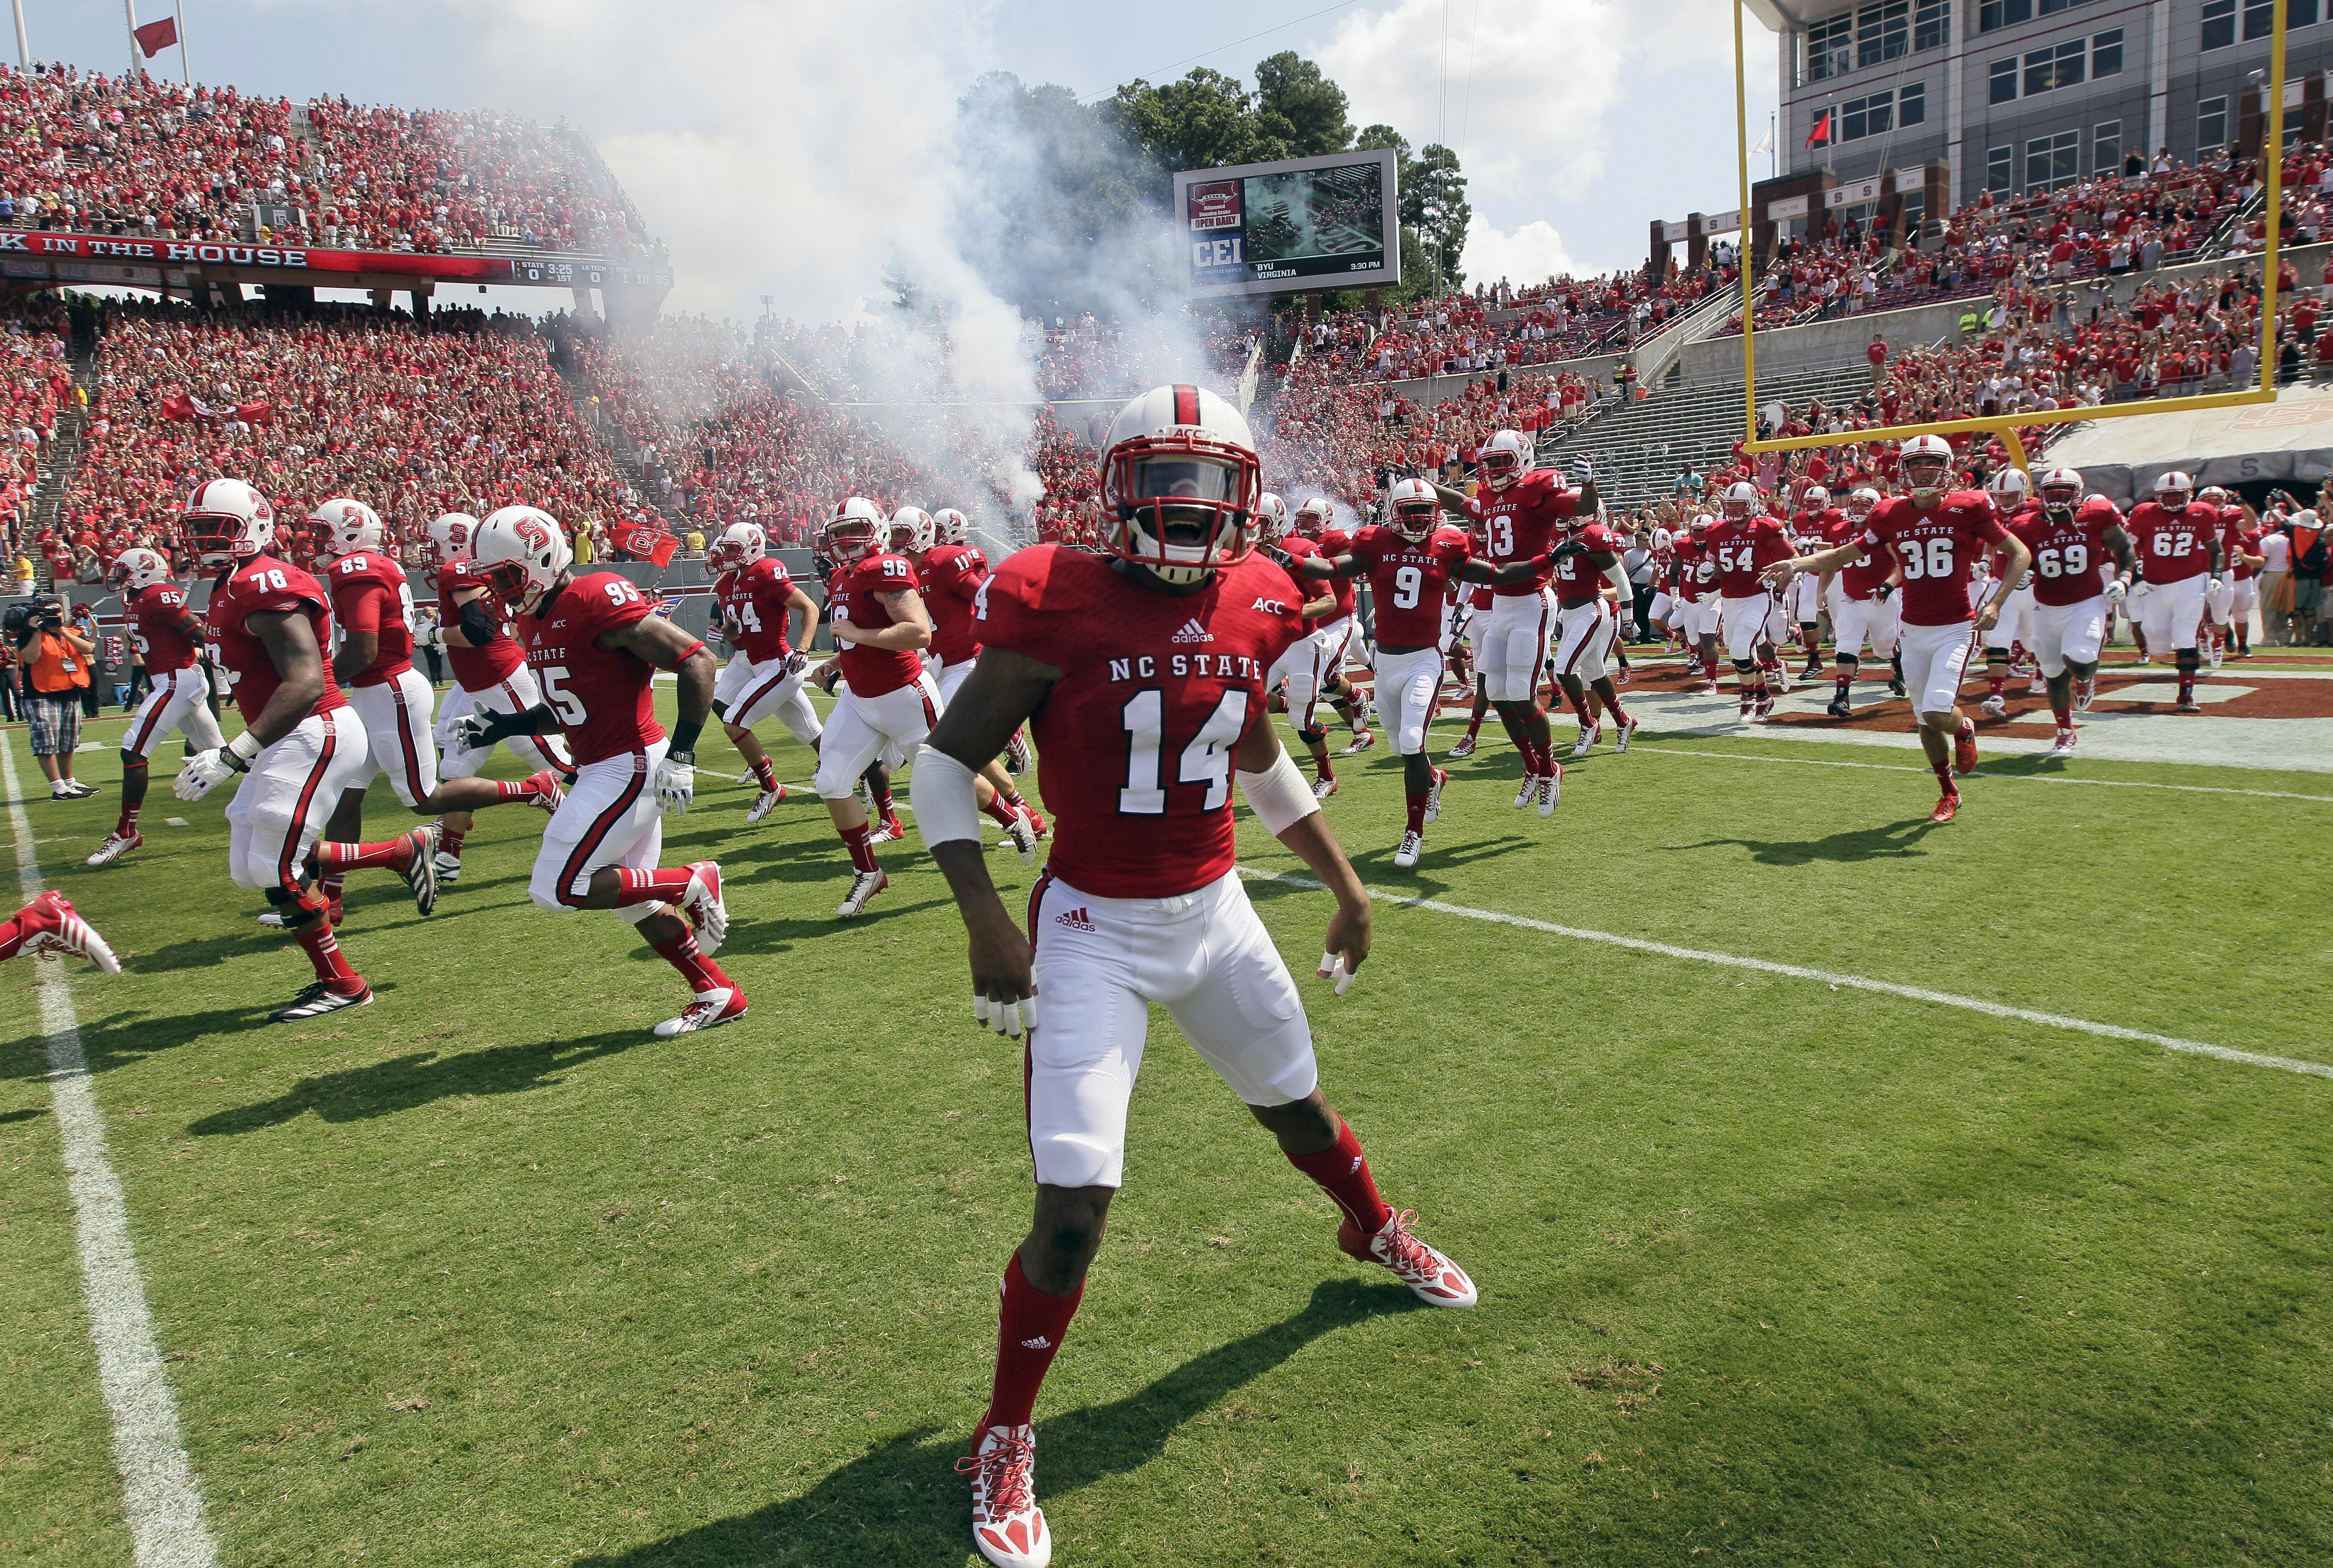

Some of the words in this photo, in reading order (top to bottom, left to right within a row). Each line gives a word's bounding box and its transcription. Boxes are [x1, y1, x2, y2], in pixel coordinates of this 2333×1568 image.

[1195, 217, 1214, 228] OPEN
[1216, 215, 1236, 226] DAILY
[42, 238, 78, 252] IN
[88, 241, 155, 257] THE
[166, 243, 307, 267] HOUSE
[1193, 238, 1242, 267] CEI
[529, 269, 539, 280] 0
[548, 264, 573, 275] 3:25
[1257, 263, 1273, 271] BYU
[1257, 269, 1297, 279] VIRGINIA
[591, 272, 600, 283] 0
[1174, 429, 1204, 438] ACC
[1552, 474, 1567, 490] 13
[1492, 503, 1517, 513] STATE
[1485, 515, 1514, 558] 13
[1897, 530, 1909, 539] NC
[1915, 527, 1954, 536] STATE
[2037, 540, 2049, 549] NC
[2054, 535, 2087, 544] STATE
[2153, 532, 2194, 557] 62
[340, 555, 368, 575] 89
[954, 554, 970, 571] 11
[1402, 555, 1438, 566] STATE
[1719, 547, 1754, 572] 54
[1898, 538, 1953, 580] 36
[2038, 544, 2087, 578] 69
[773, 566, 789, 580] 84
[882, 559, 907, 576] 96
[250, 569, 288, 594] 78
[1393, 566, 1422, 610] 9
[160, 591, 181, 604] 85
[603, 580, 639, 607] 95
[732, 592, 753, 600] STATE
[1251, 597, 1286, 615] ACC
[551, 619, 567, 629] ACC
[1172, 632, 1214, 643] adidas
[533, 648, 566, 661] STATE
[1109, 655, 1156, 683] NC
[1171, 653, 1262, 680] STATE
[1117, 688, 1250, 817] 14
[1055, 916, 1096, 932] adidas
